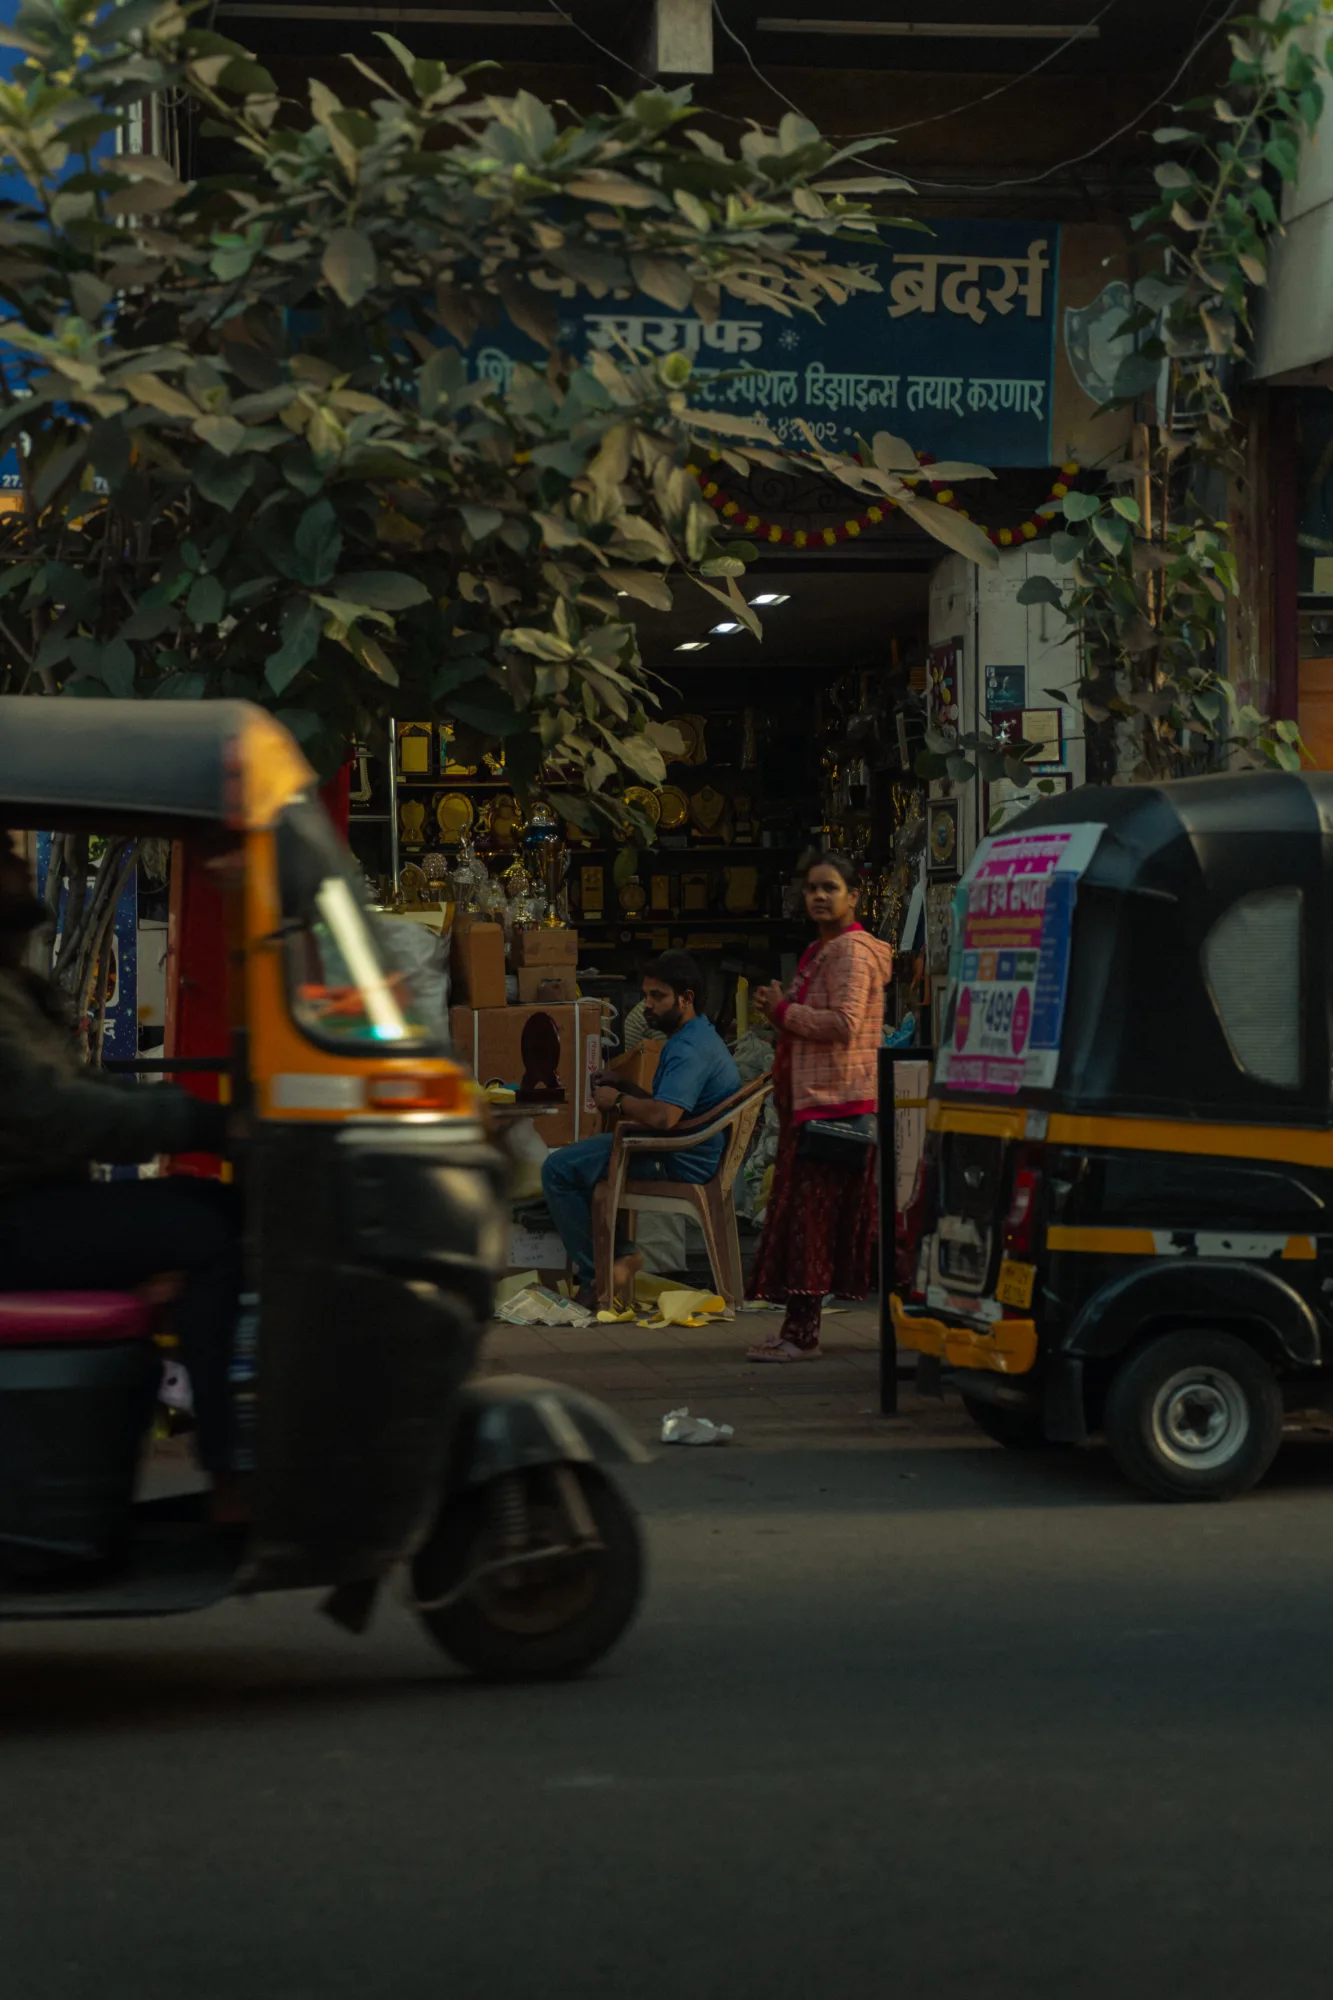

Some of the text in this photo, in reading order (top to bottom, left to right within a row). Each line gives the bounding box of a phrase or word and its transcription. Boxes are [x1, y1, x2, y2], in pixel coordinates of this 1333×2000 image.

[887, 239, 1049, 325] ब्रदर्स
[804, 361, 900, 413] डिझाइन्स
[907, 376, 965, 418] तयार
[967, 377, 1046, 422] करणार
